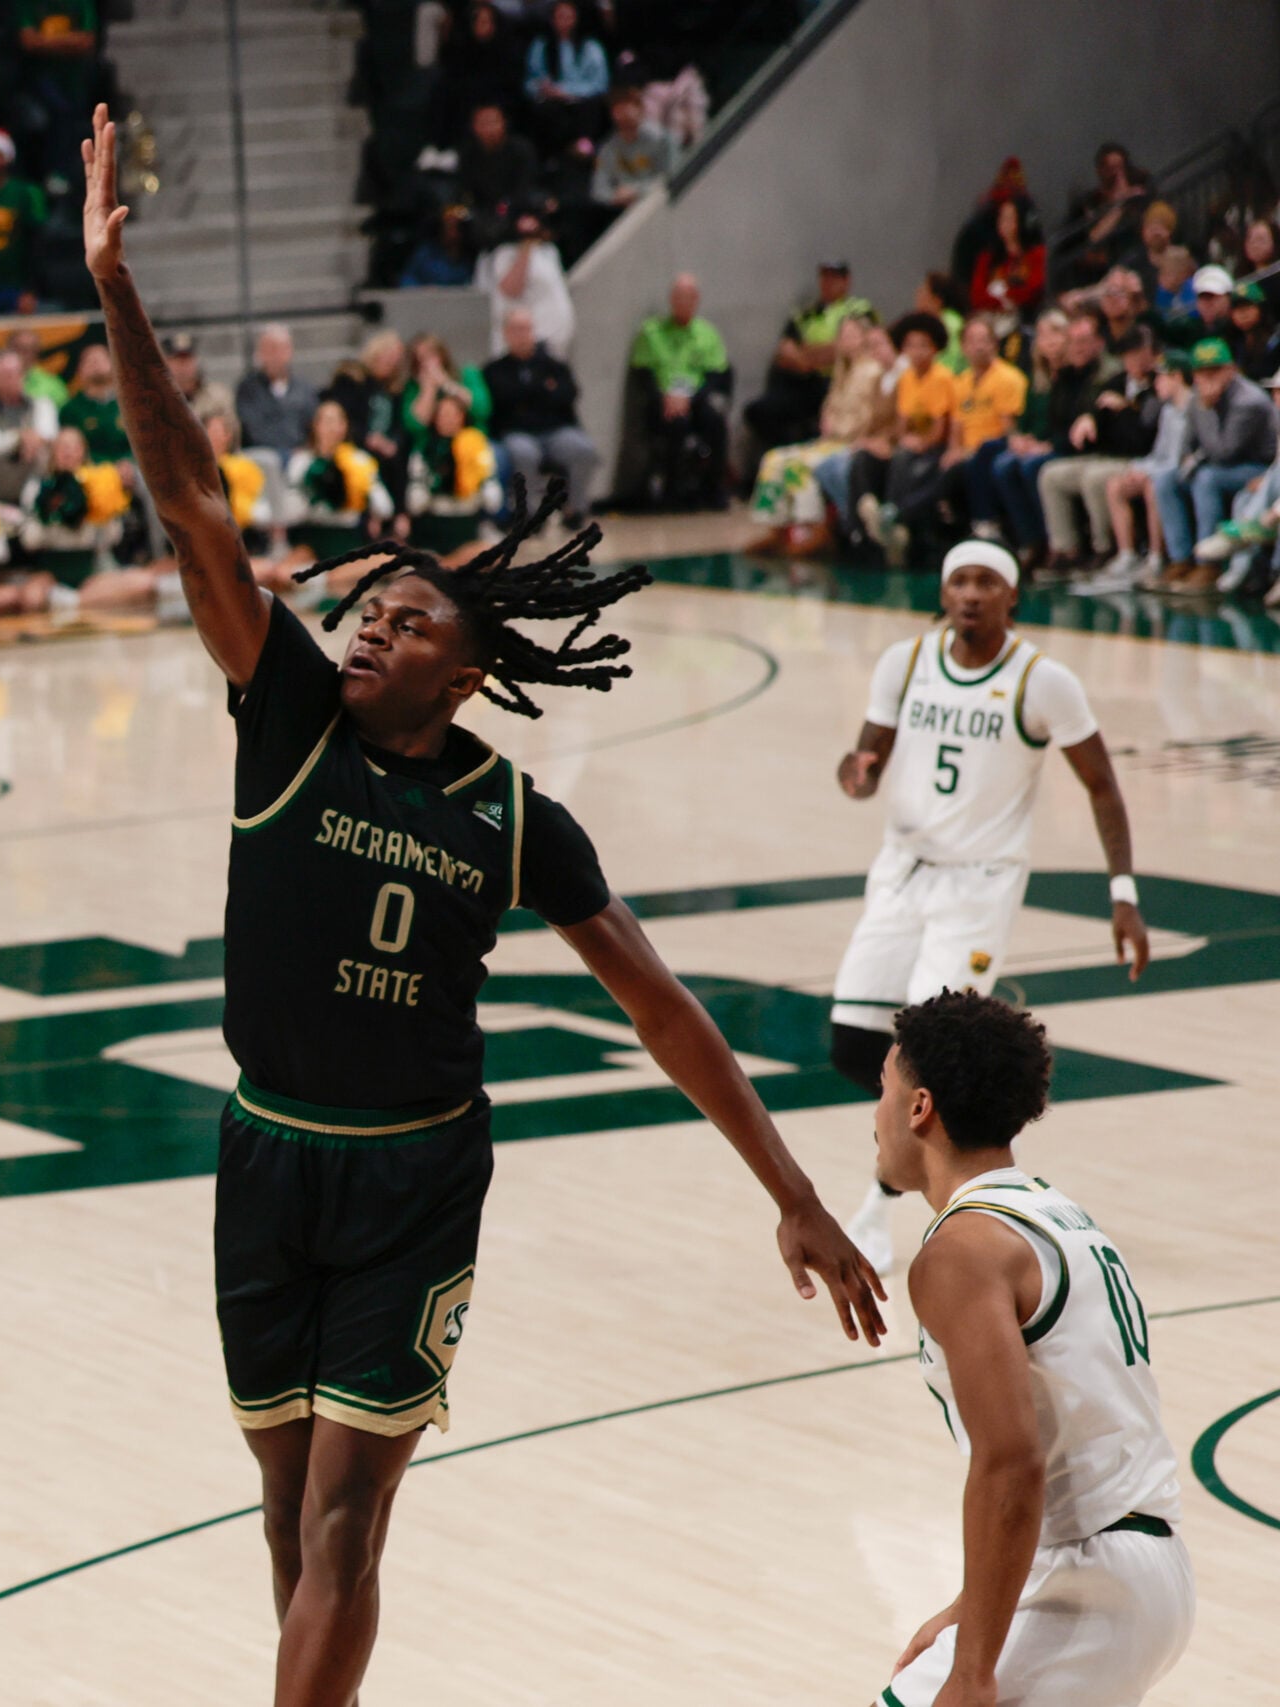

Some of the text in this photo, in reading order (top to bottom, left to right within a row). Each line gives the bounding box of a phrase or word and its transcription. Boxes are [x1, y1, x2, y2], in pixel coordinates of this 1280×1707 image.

[910, 701, 1004, 741] BAYLOR
[935, 745, 963, 794] 5
[315, 808, 485, 894] SACRAMENTO
[370, 882, 415, 953] 0
[334, 959, 423, 1007] STATE
[1089, 1245, 1150, 1367] 10
